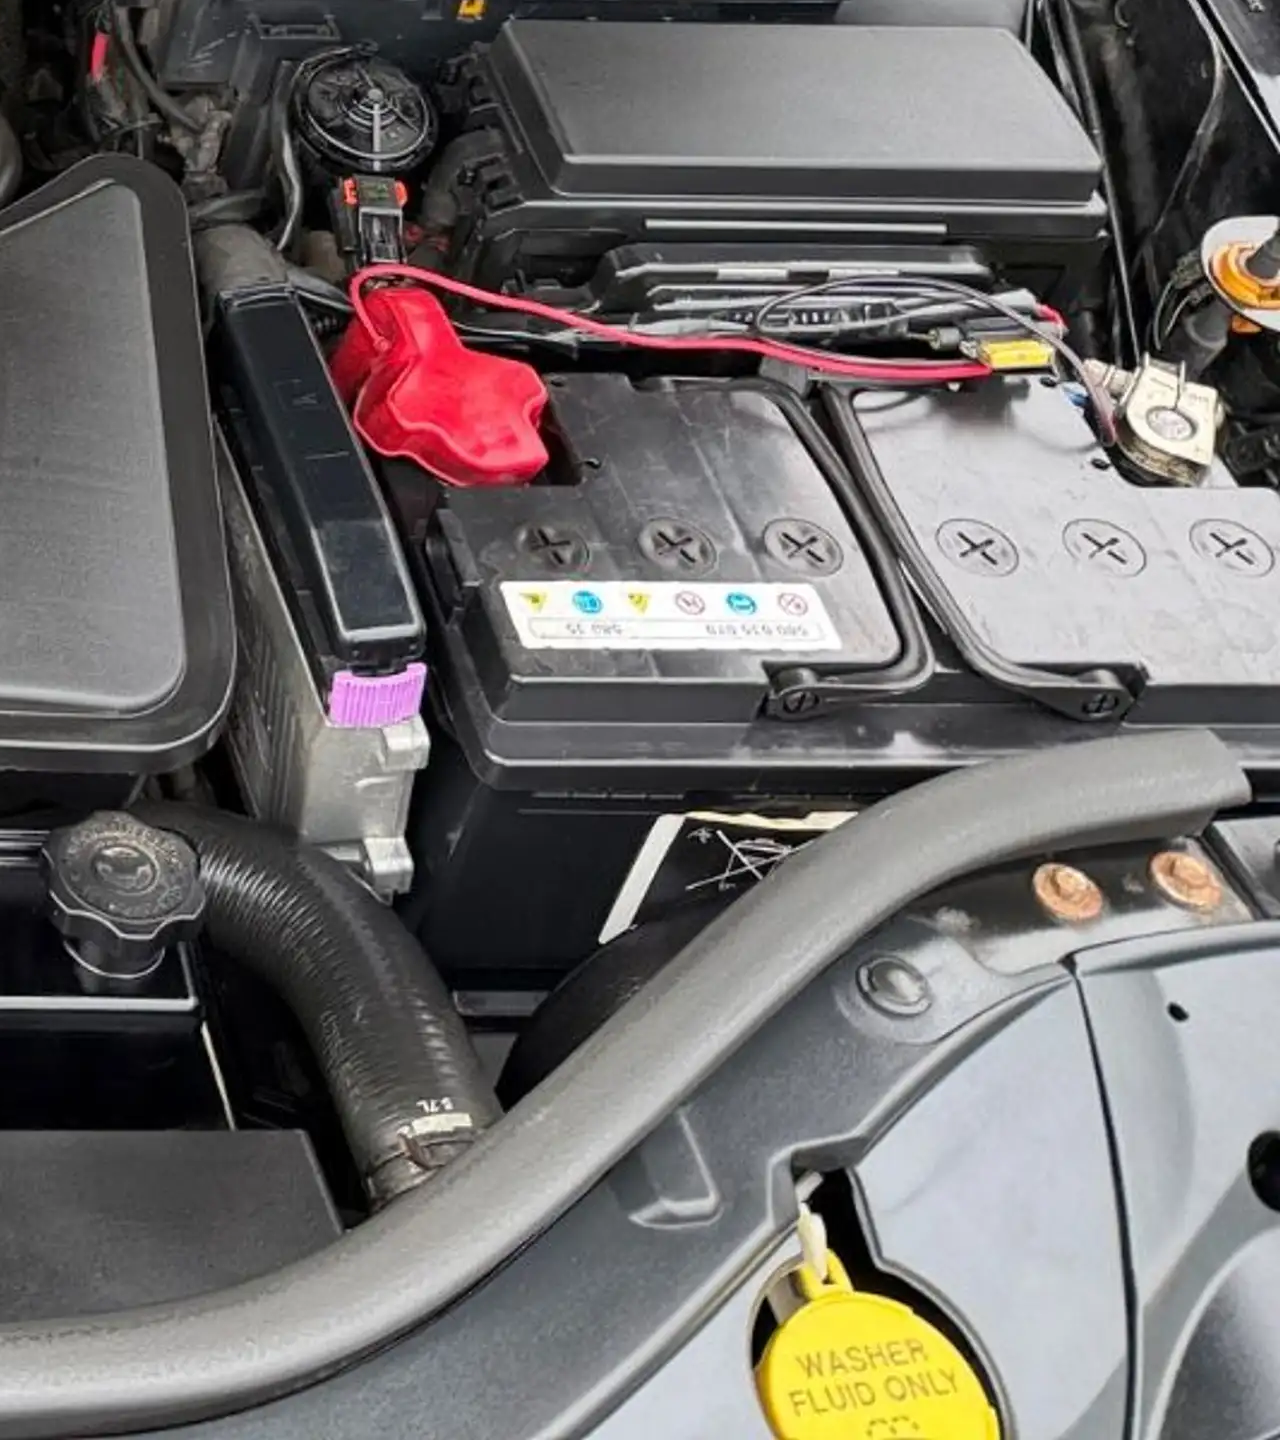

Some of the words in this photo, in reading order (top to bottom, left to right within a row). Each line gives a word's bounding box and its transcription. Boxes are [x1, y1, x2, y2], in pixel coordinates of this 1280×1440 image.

[795, 1337, 930, 1380] WASHER
[787, 1380, 876, 1417] FLUID
[882, 1367, 962, 1402] ONLY
